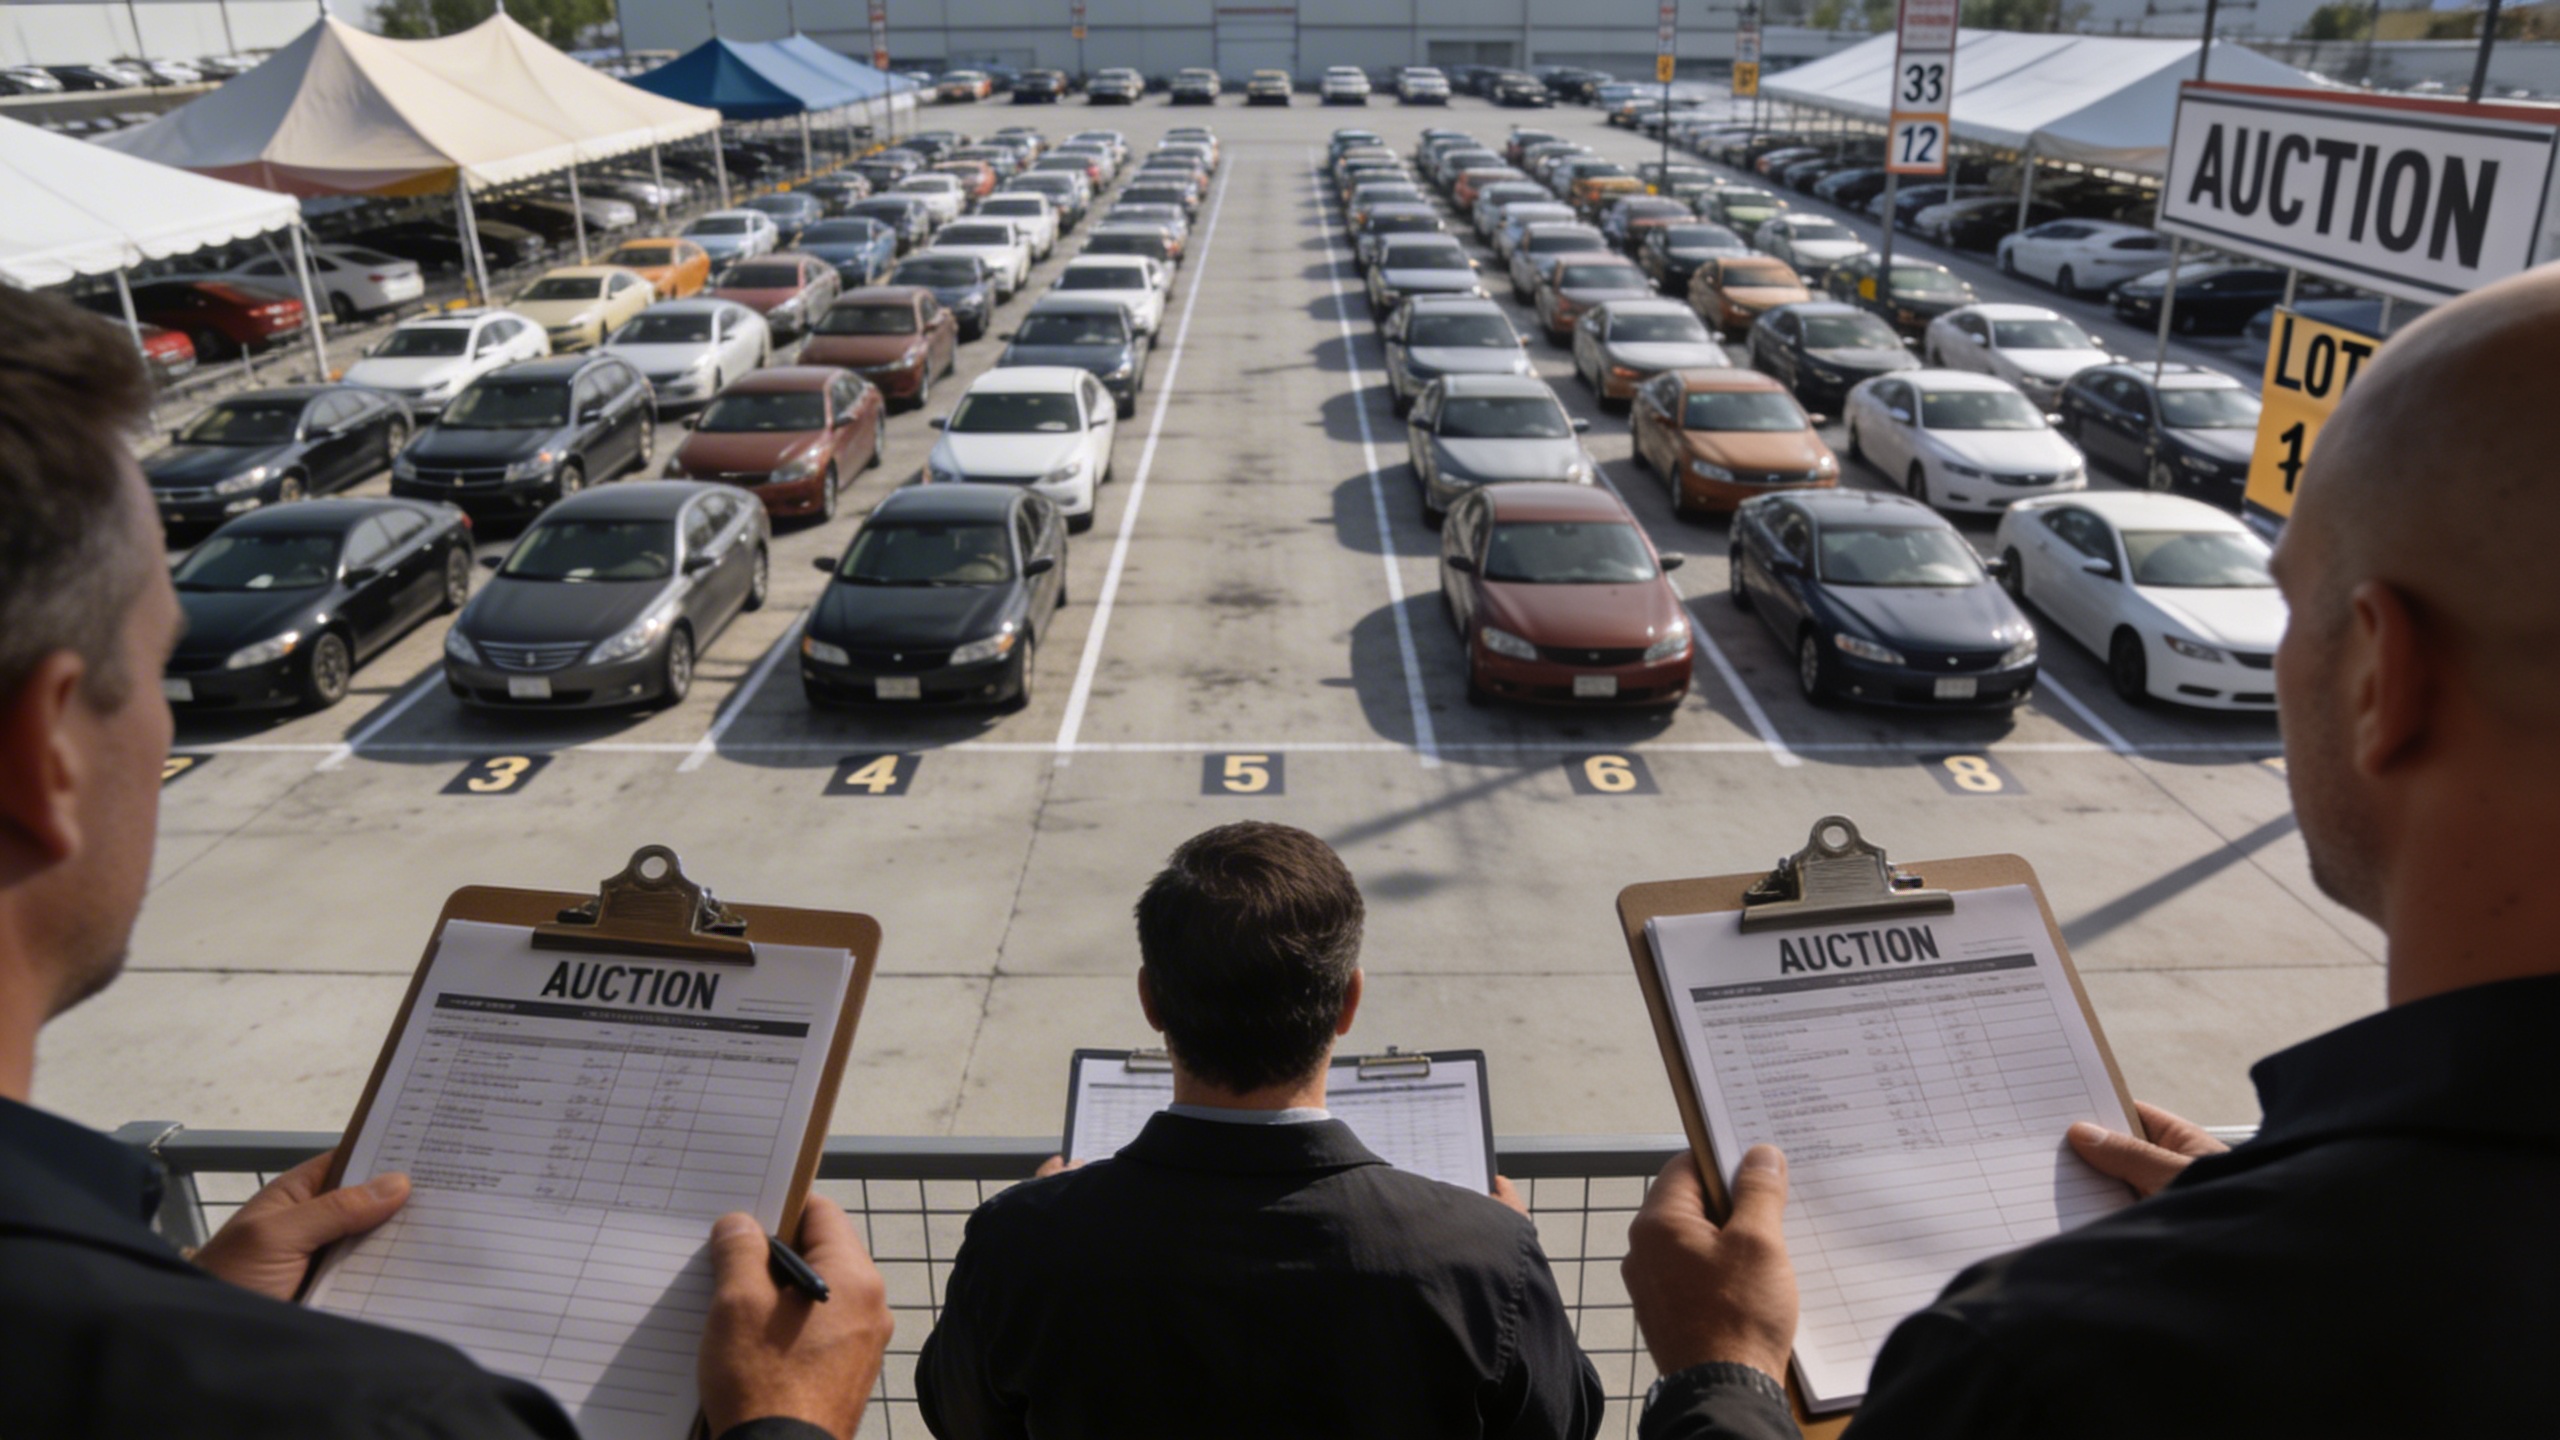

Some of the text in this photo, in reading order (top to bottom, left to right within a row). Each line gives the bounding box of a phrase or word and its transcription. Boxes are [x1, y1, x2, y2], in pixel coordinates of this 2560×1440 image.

[1904, 64, 1944, 103] 33
[1900, 124, 1938, 163] 12
[2188, 123, 2500, 270] AUCTION
[467, 756, 530, 792] 3
[845, 754, 899, 794] 4
[1222, 755, 1269, 793] 5
[1583, 755, 1637, 793] 6
[1943, 755, 2003, 792] 8
[1779, 924, 1940, 975] AUCTION
[540, 960, 721, 1011] AUCTION
